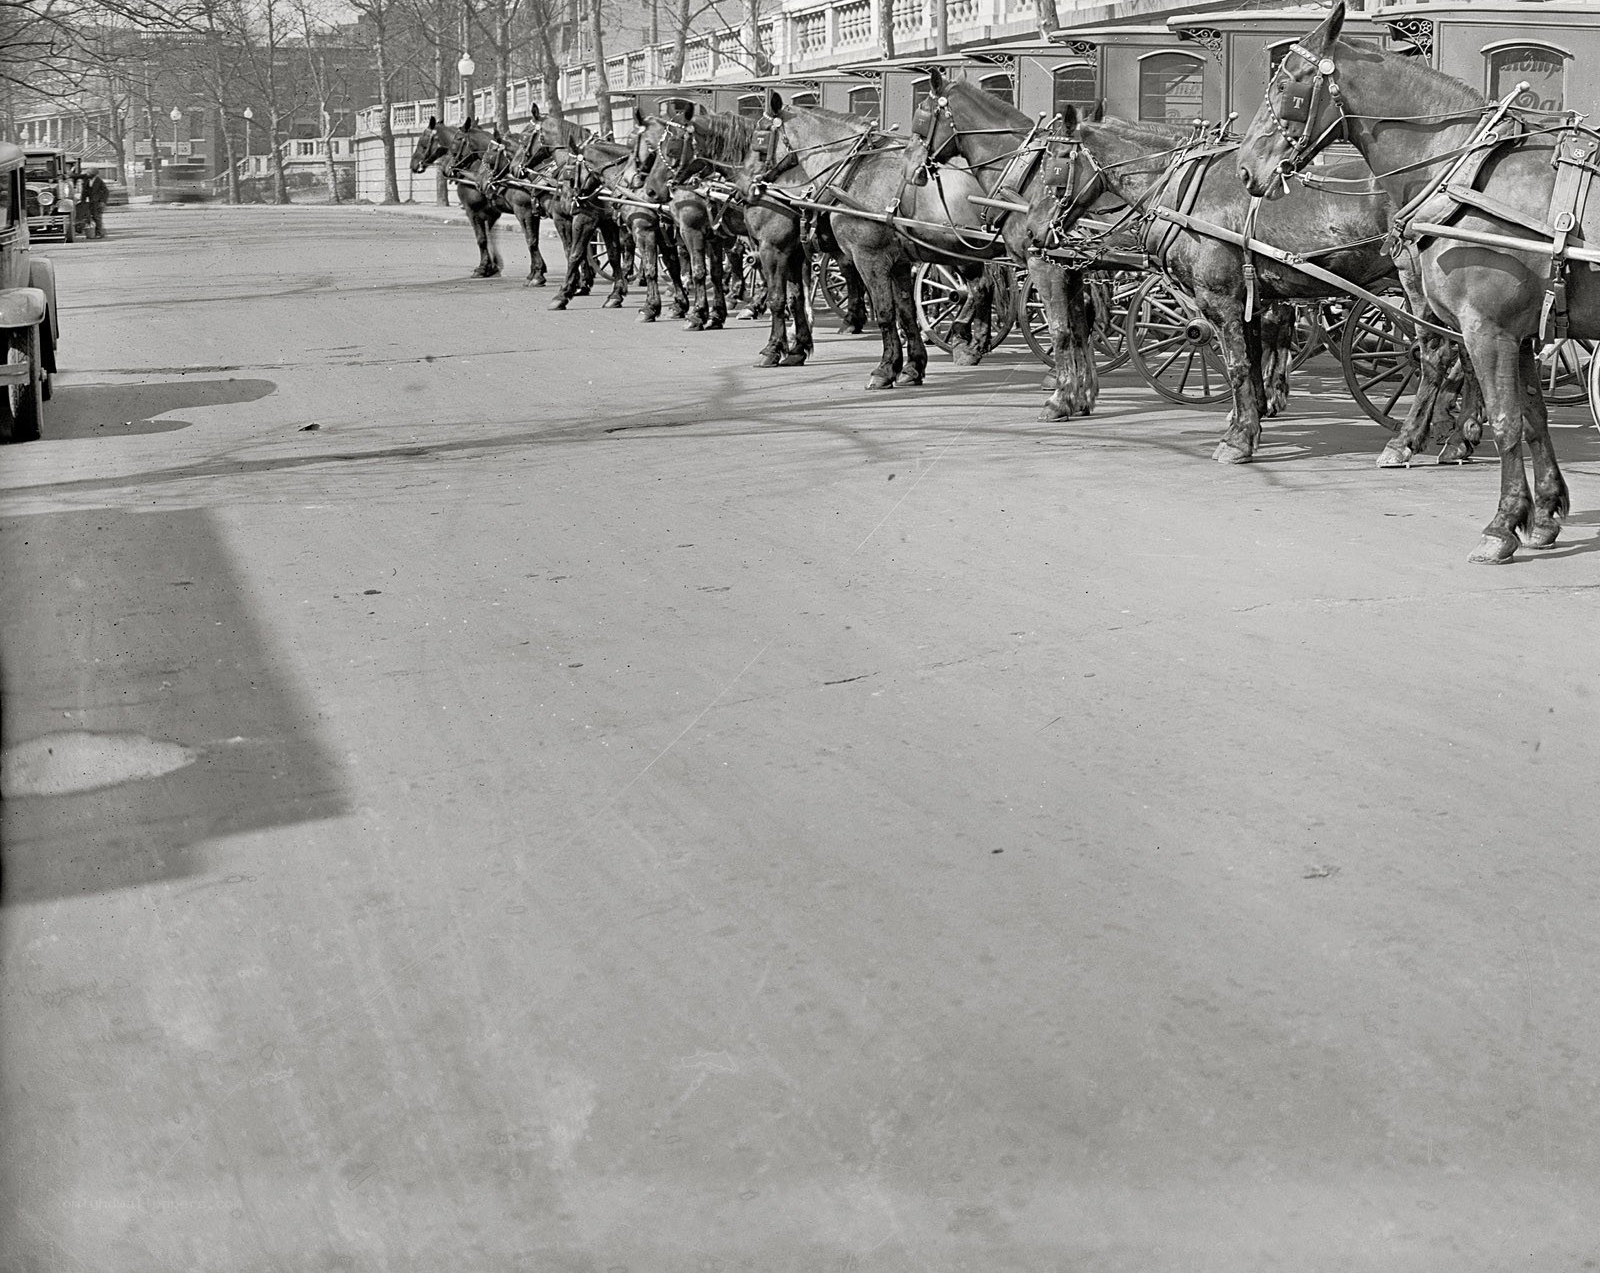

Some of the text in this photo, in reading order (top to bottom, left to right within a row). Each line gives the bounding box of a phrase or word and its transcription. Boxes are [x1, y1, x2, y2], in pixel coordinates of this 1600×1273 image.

[1292, 96, 1304, 109] T
[757, 137, 765, 145] T
[1054, 167, 1062, 176] T
